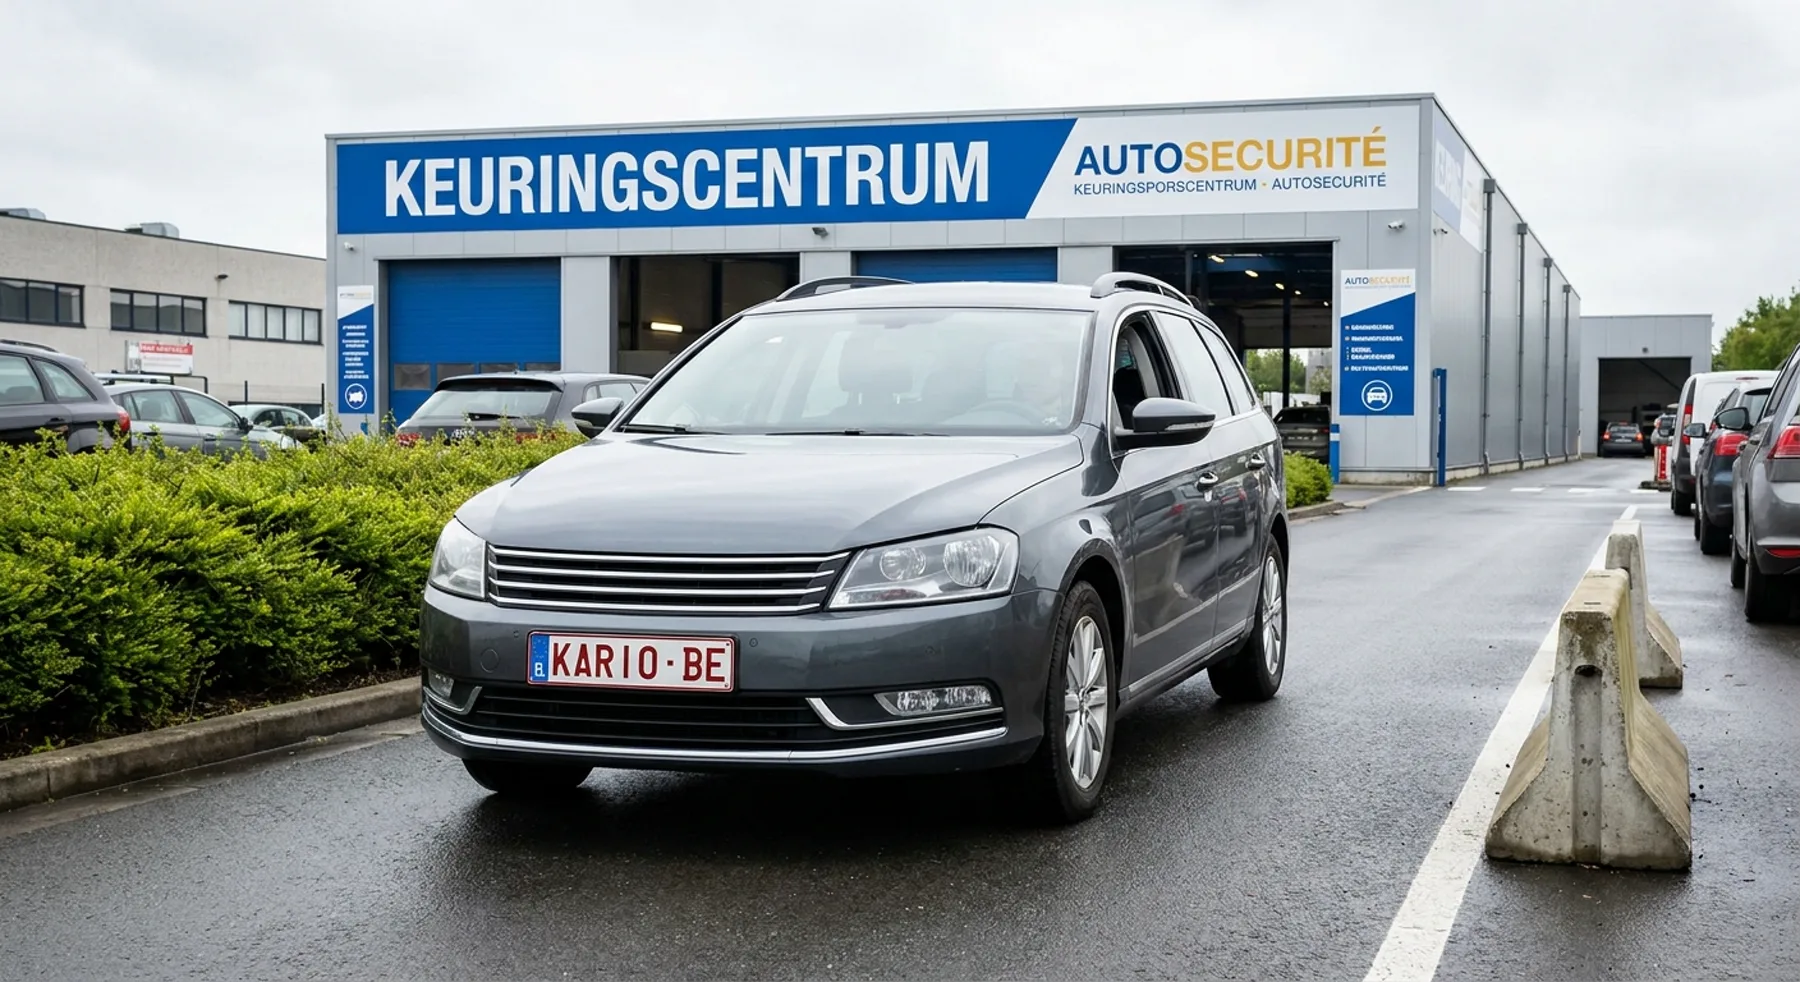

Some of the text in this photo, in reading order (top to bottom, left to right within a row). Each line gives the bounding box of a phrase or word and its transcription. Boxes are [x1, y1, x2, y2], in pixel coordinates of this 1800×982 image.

[1074, 126, 1387, 176] AUTOSECURITÉ
[384, 141, 990, 217] KEURINGSCENTRUM
[1074, 172, 1387, 196] KEURINGSPORSCENTRUM AUTOSECURITÉ
